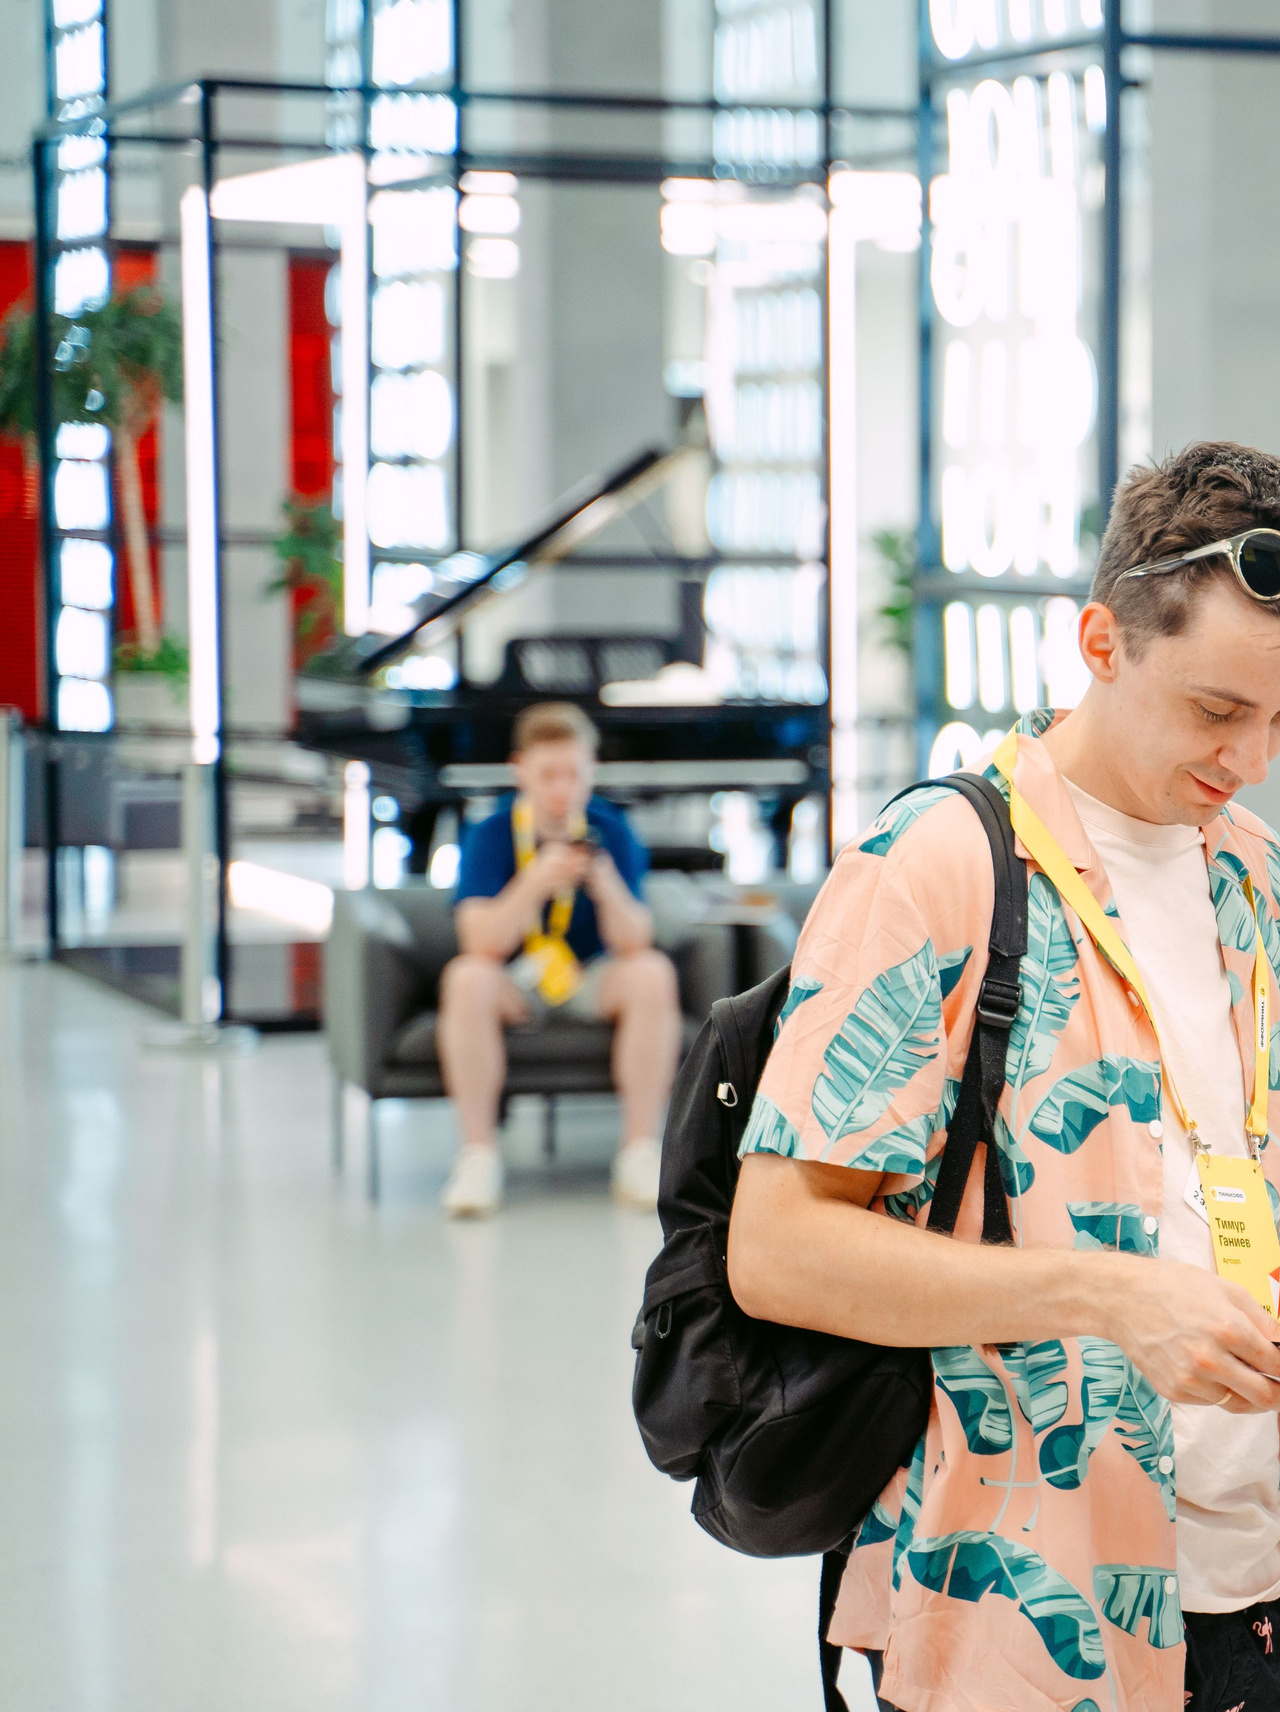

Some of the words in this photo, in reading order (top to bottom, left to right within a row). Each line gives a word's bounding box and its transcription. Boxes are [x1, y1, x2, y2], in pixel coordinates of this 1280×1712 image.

[1218, 1191, 1244, 1199] ТИНЬКОФФ
[1215, 1217, 1246, 1233] Тимур
[1218, 1235, 1251, 1248] Ганиев
